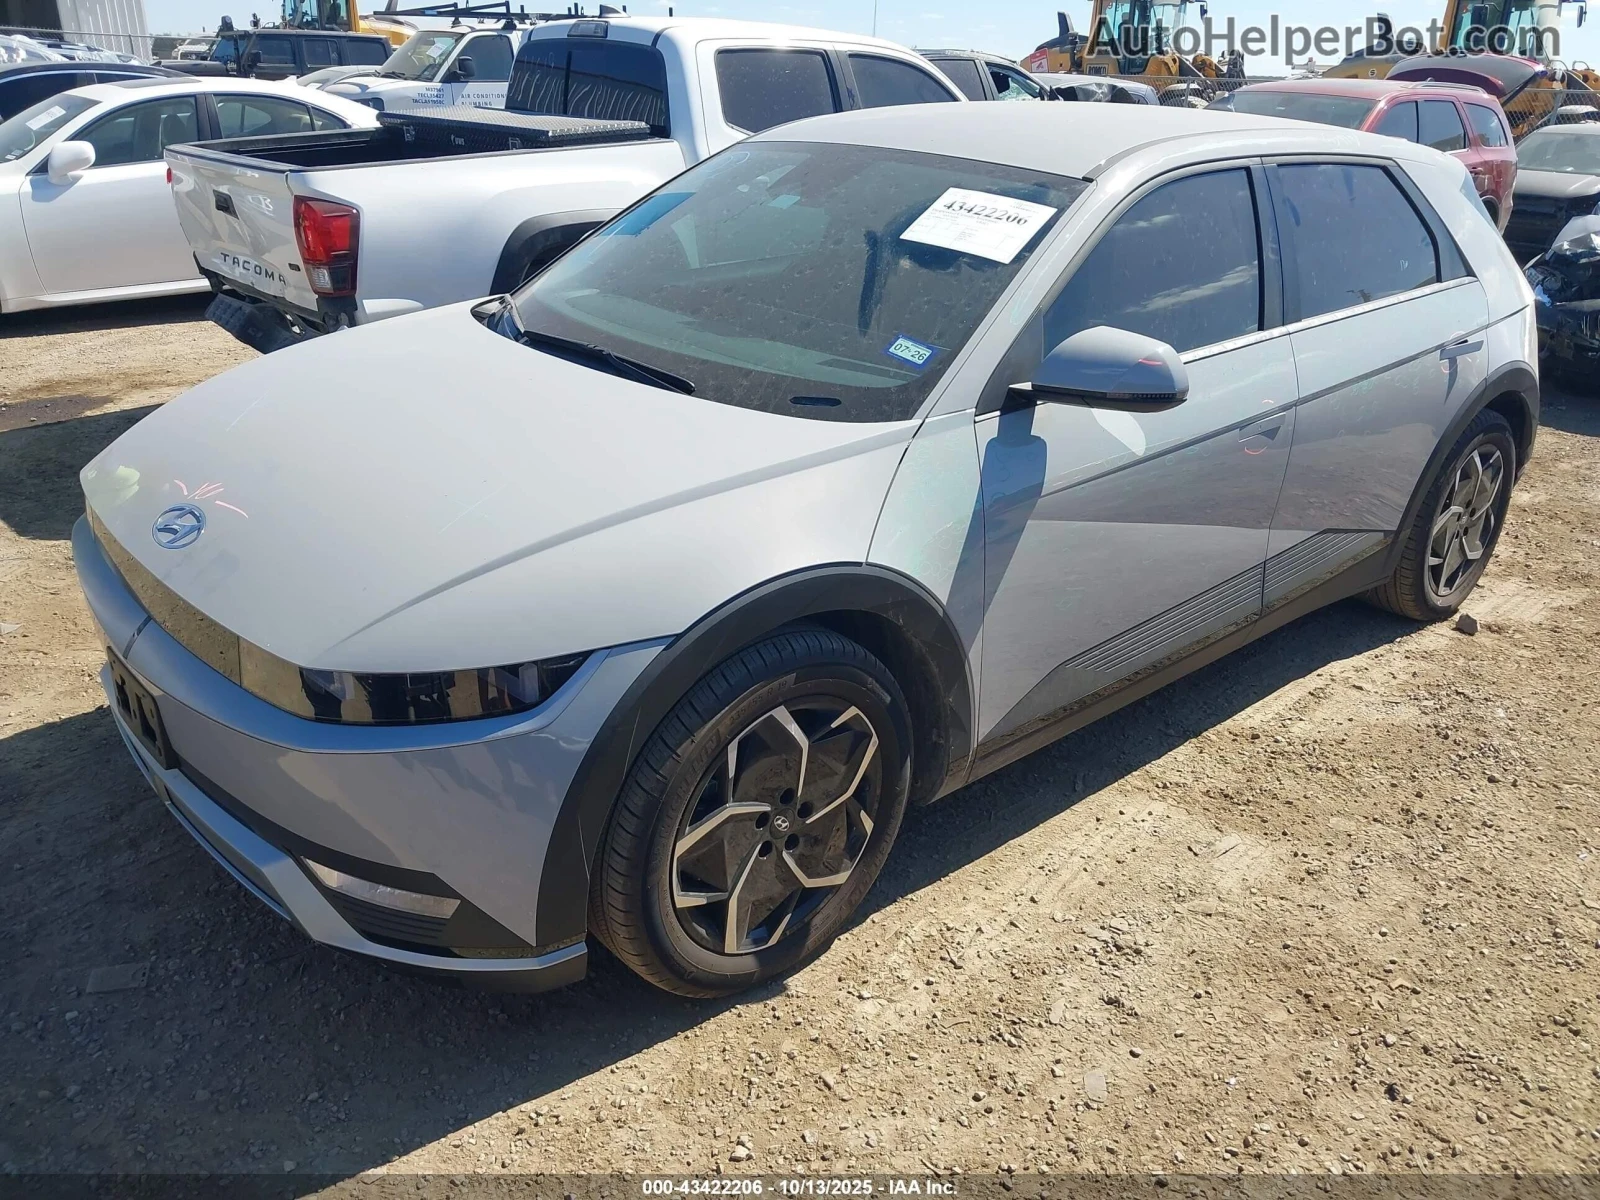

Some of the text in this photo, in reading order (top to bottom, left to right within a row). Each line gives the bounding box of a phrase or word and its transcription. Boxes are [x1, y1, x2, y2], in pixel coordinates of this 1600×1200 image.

[943, 200, 1028, 226] 43422206
[220, 252, 287, 286] TACOMA
[767, 686, 772, 696] R
